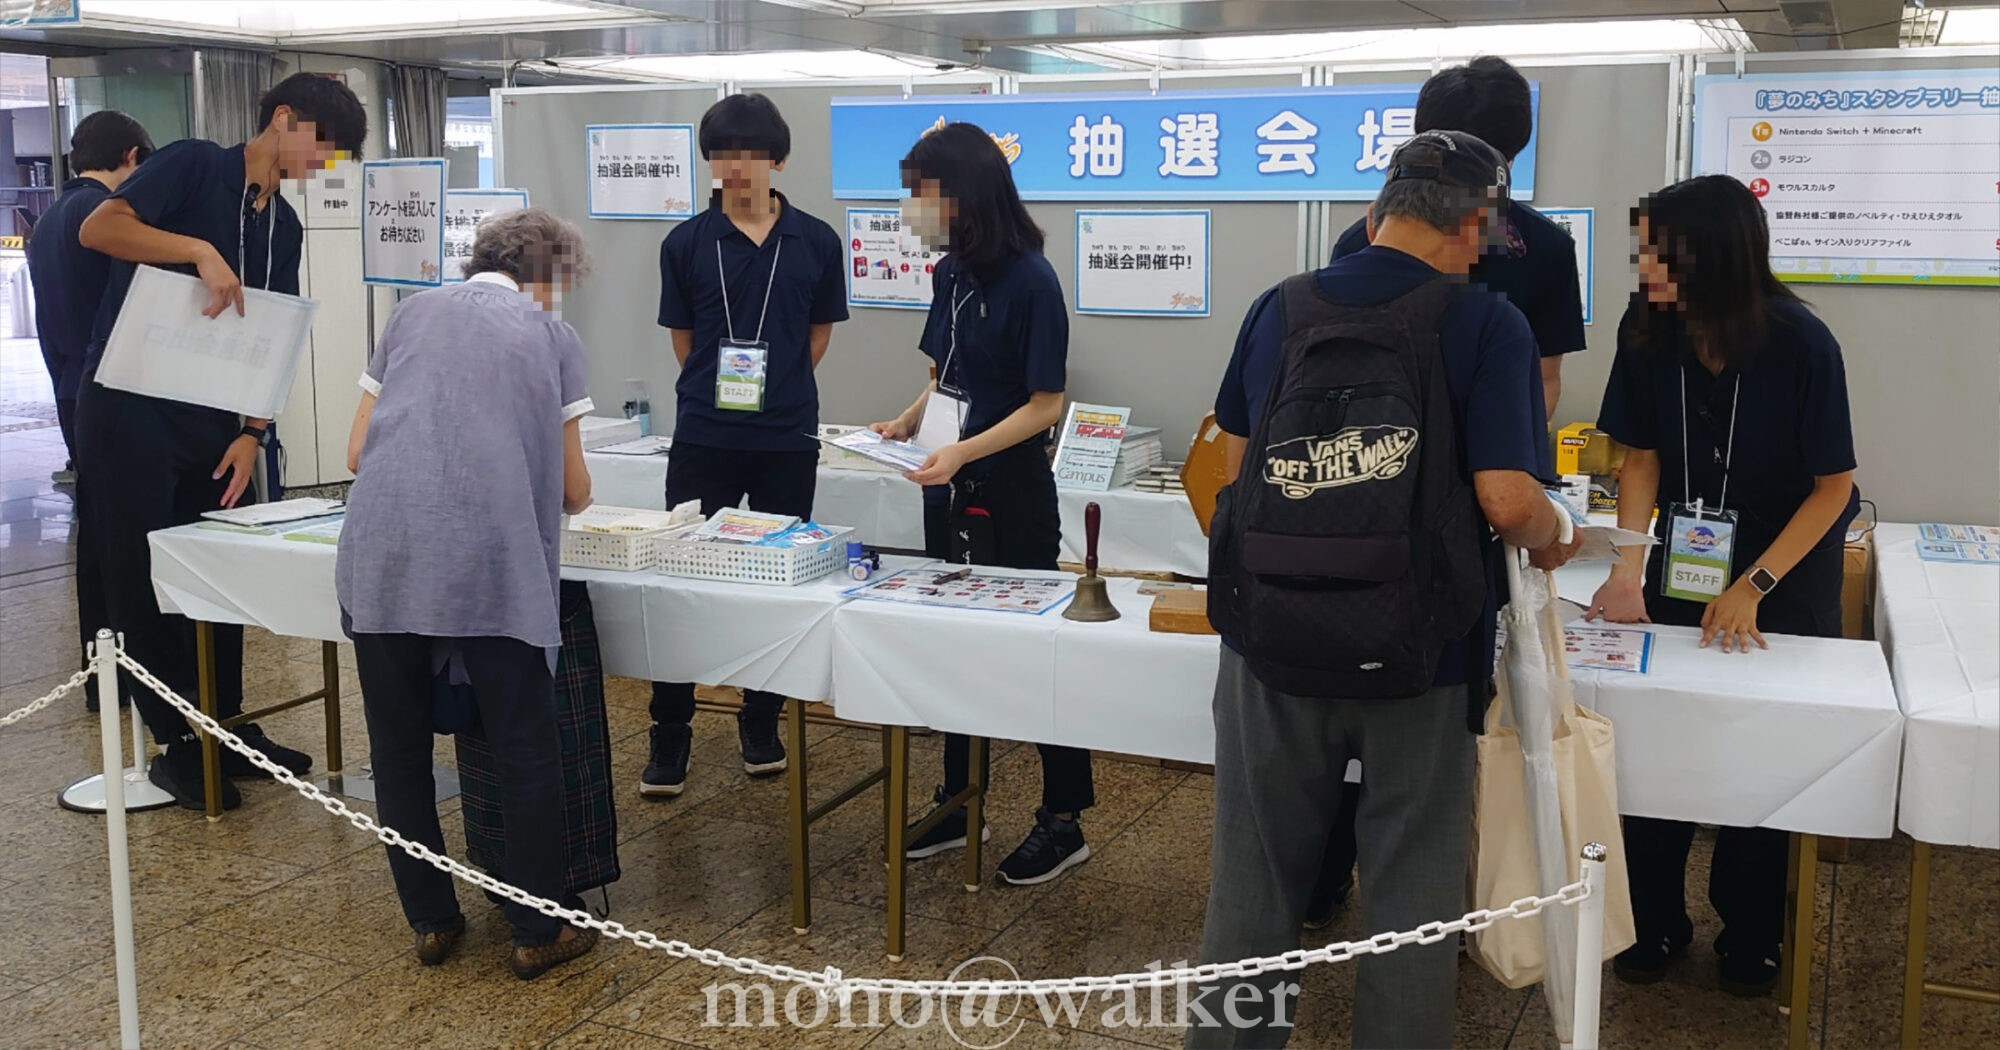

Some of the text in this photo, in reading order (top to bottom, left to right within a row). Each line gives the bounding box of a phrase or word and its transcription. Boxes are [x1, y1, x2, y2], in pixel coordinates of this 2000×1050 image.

[1779, 127, 1823, 136] Nintendo
[1826, 127, 1859, 136] Switch
[1873, 126, 1922, 136] Minecraft
[1778, 154, 1812, 164] ラジコン
[597, 162, 681, 178] 抽選会開催中!
[1777, 183, 1836, 192] モウルスカルタ
[324, 199, 349, 209] 作動中
[368, 200, 437, 217] アンケートを記入して
[380, 226, 425, 243] お待ちください
[1088, 253, 1192, 271] 抽選会開催中!
[723, 386, 755, 397] STAFF
[1306, 431, 1364, 462] VANS
[1312, 451, 1356, 482] THE
[1057, 466, 1107, 485] Campus
[1675, 570, 1720, 587] STAFF
